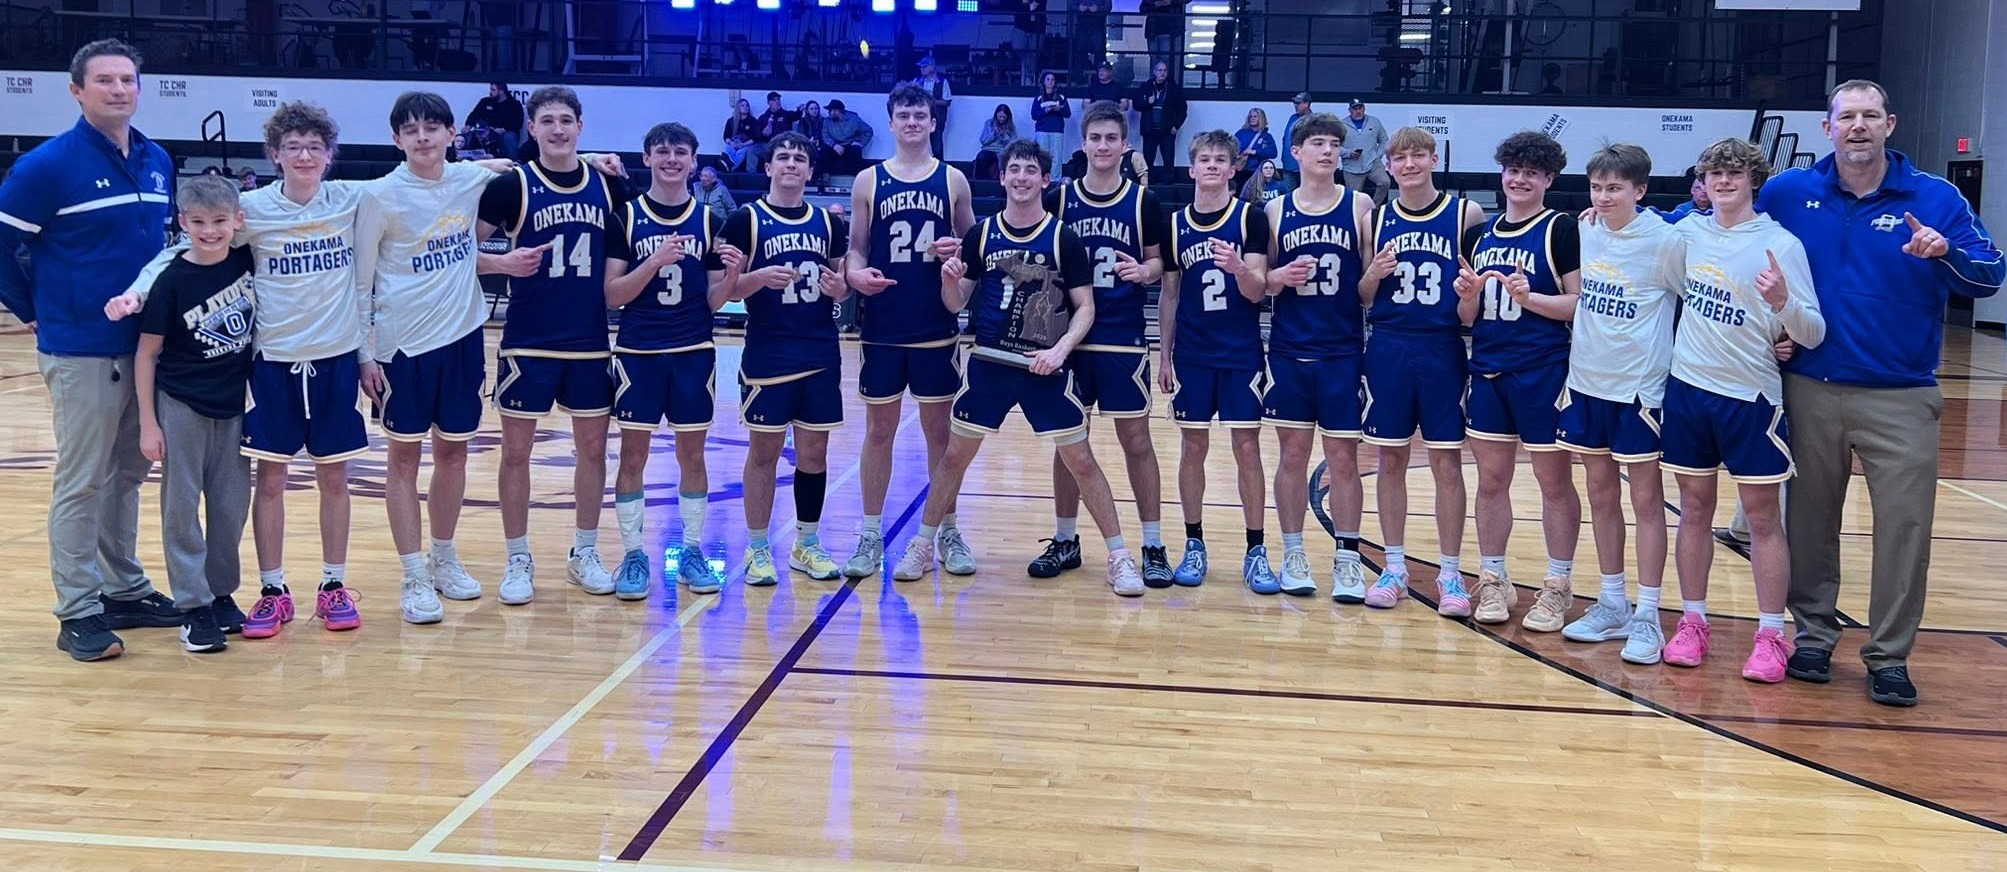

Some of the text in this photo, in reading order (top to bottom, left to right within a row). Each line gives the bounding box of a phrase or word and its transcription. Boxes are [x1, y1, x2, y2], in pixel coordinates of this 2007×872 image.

[7, 77, 16, 87] TC
[160, 80, 187, 90] TC CHR
[252, 89, 278, 98] VISITING
[253, 100, 277, 108] ADULTS
[1415, 126, 1449, 135] UDENTS
[1418, 116, 1447, 124] VISITING
[1662, 115, 1694, 123] ONEKAMA
[1662, 124, 1693, 132] STUDENTS
[533, 202, 605, 232] ONEKAMA
[880, 190, 945, 220] ONEKAMA
[284, 236, 344, 255] ONEKAMA
[889, 220, 937, 263] 24
[1068, 217, 1131, 246] NEKAMA
[1283, 224, 1351, 253] ONEKAMA
[1390, 231, 1453, 260] NEKAMA
[269, 246, 354, 275] PORTAGERS
[549, 232, 592, 278] 14
[635, 235, 703, 261] ONEMA
[1181, 240, 1242, 269] ONEK
[1474, 247, 1536, 275] ONEKAMA
[657, 264, 682, 306] 3
[782, 260, 821, 304] 13
[1296, 253, 1341, 296] 23
[1391, 261, 1442, 305] 33
[1581, 277, 1624, 298] NEKAMA
[1202, 268, 1228, 312] 2
[1483, 276, 1522, 321] 10
[1685, 277, 1731, 304] NEKAMA
[1008, 291, 1025, 339] CHAMPION
[1581, 291, 1638, 320] TAGERS
[1685, 291, 1746, 327] TAGERS
